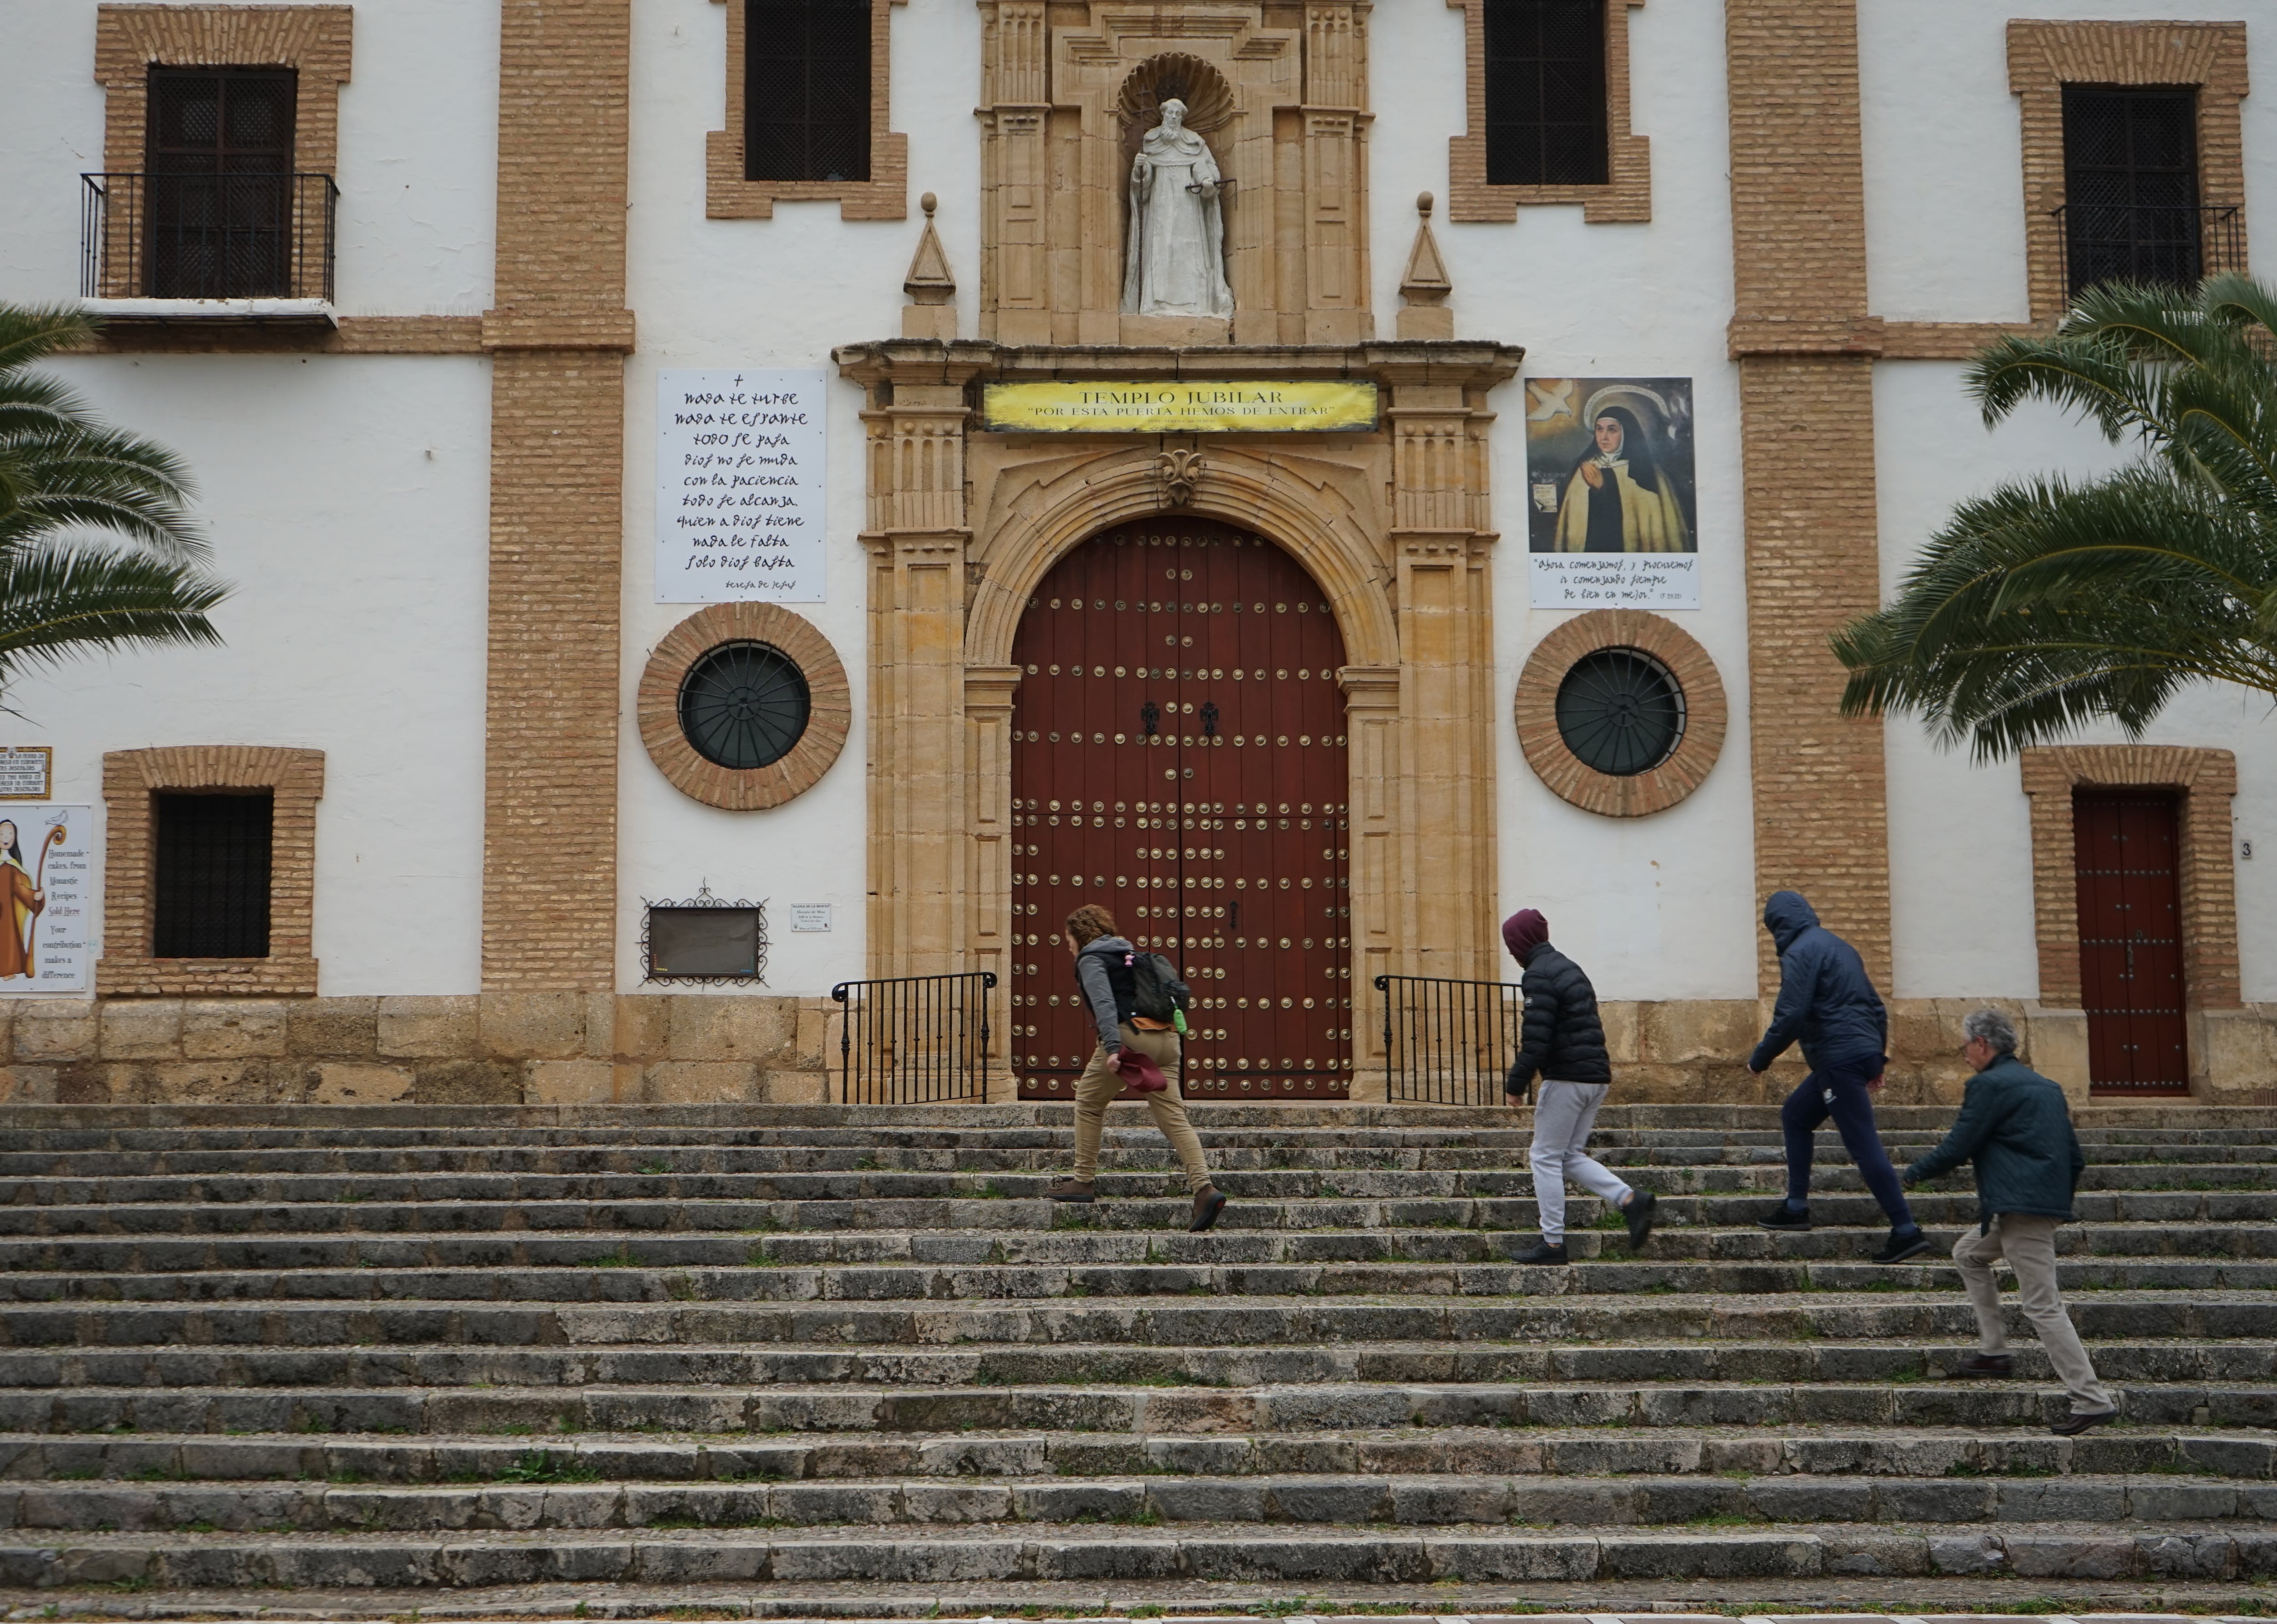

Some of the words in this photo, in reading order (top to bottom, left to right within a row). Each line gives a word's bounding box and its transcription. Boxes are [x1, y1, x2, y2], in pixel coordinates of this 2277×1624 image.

[684, 393, 725, 405] nada
[729, 393, 747, 405] te
[751, 393, 798, 405] turbe
[1078, 392, 1176, 404] TEMPLO
[1187, 391, 1283, 405] JUBILAR
[1072, 407, 1109, 416] ESTA
[1117, 407, 1172, 416] PUERTA
[674, 413, 715, 425] nada
[720, 413, 737, 425] te
[693, 433, 729, 445] todo
[717, 456, 733, 465] no
[759, 453, 798, 466] muda
[684, 476, 708, 486] con
[711, 473, 727, 485] la
[730, 475, 799, 489] paciencia
[682, 494, 714, 507] todo
[677, 515, 716, 529] quien
[720, 518, 730, 526] a
[765, 514, 805, 526] tiene
[692, 535, 728, 548] nada
[730, 534, 747, 547] le
[758, 580, 769, 589] de
[1564, 589, 1576, 599] de
[1581, 588, 1600, 599] bien
[48, 849, 84, 859] Homemade
[2243, 843, 2251, 856] 3
[70, 861, 87, 870] from
[49, 876, 78, 886] Monastic
[51, 891, 77, 901] Recipes
[48, 906, 62, 916] Sold
[64, 906, 80, 916] Here
[50, 925, 67, 935] Your
[42, 940, 82, 949] contribution
[44, 955, 66, 963] makes
[41, 970, 76, 978] difference
